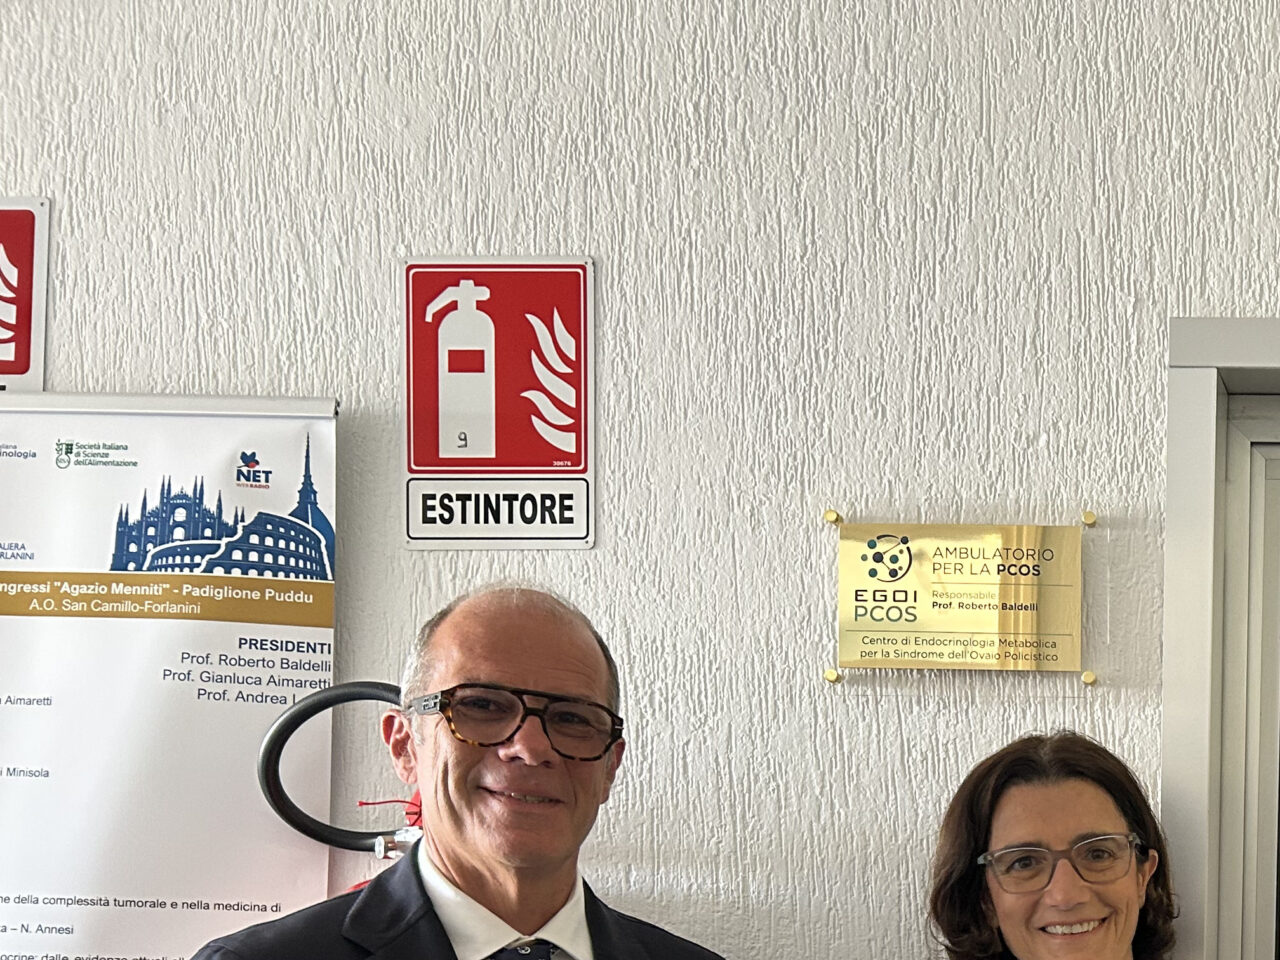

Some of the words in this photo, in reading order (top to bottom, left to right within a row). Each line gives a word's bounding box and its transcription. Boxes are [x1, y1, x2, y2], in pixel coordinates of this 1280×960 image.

[102, 442, 129, 451] Italiana
[82, 451, 110, 459] Scienze
[236, 469, 272, 484] NET
[421, 493, 575, 525] ESTINTORE
[931, 546, 1055, 562] AMBULATORIO
[931, 563, 964, 575] PER
[969, 563, 991, 576] LA
[996, 563, 1041, 577] PCOS
[53, 582, 108, 597] "Agazio
[111, 582, 170, 595] Menniti"
[182, 584, 261, 600] Padiglione
[265, 588, 314, 604] Puddu
[29, 599, 58, 611] A.O.
[62, 599, 87, 612] San
[90, 600, 201, 614] Camillo-Forlanini
[854, 605, 918, 623] PCOS
[957, 601, 999, 611] Roberto
[1001, 602, 1039, 612] Baldelli
[238, 637, 332, 655] PRESIDENTI
[861, 636, 898, 646] Centro
[900, 636, 911, 646] di
[914, 636, 995, 650] Endocrinologia
[998, 638, 1058, 649] Metabolica
[181, 652, 214, 666] Prof.
[218, 654, 276, 668] Roberto
[280, 657, 332, 672] Baldelli
[860, 650, 878, 660] per
[881, 649, 890, 659] la
[893, 649, 945, 660] Sindrome
[1004, 651, 1059, 662] Policistico
[162, 669, 195, 682] Prof.
[199, 670, 262, 686] Gianluca
[266, 674, 331, 689] Aimaretti
[4, 695, 52, 706] Aimaretti
[197, 688, 230, 702] Prof.
[234, 690, 288, 705] Andrea
[6, 767, 50, 778] Minisola
[13, 894, 39, 905] della
[42, 895, 110, 907] complessità
[113, 897, 167, 909] tumorale
[170, 901, 178, 909] e
[182, 899, 210, 911] nella
[213, 901, 267, 913] medicina
[270, 903, 281, 914] di
[20, 923, 32, 934] N.
[35, 924, 74, 935] Annesi
